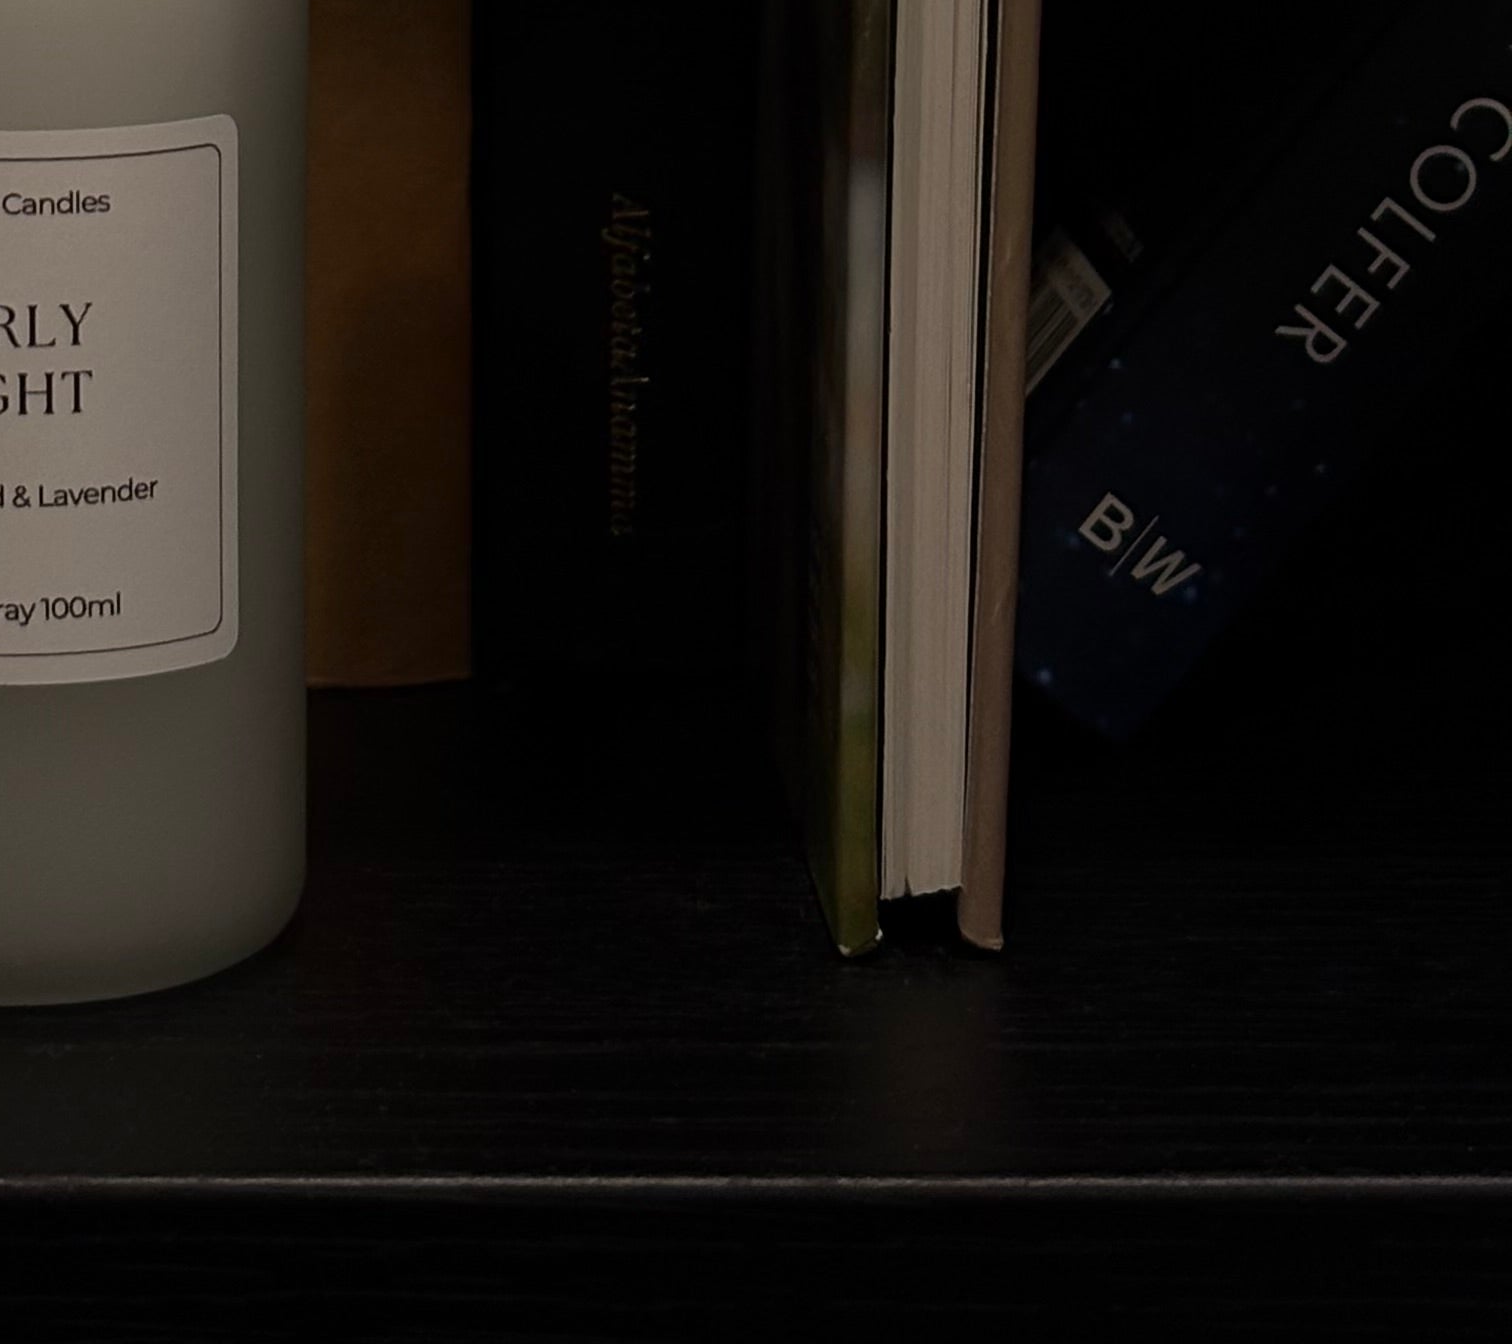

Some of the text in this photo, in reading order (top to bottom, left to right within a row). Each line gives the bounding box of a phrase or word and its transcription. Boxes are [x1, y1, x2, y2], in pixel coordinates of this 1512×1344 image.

[1, 189, 111, 216] Candles
[1273, 96, 1512, 366] COLFER
[12, 484, 32, 509] &
[38, 476, 158, 508] Lavender
[41, 591, 122, 622] 100ml
